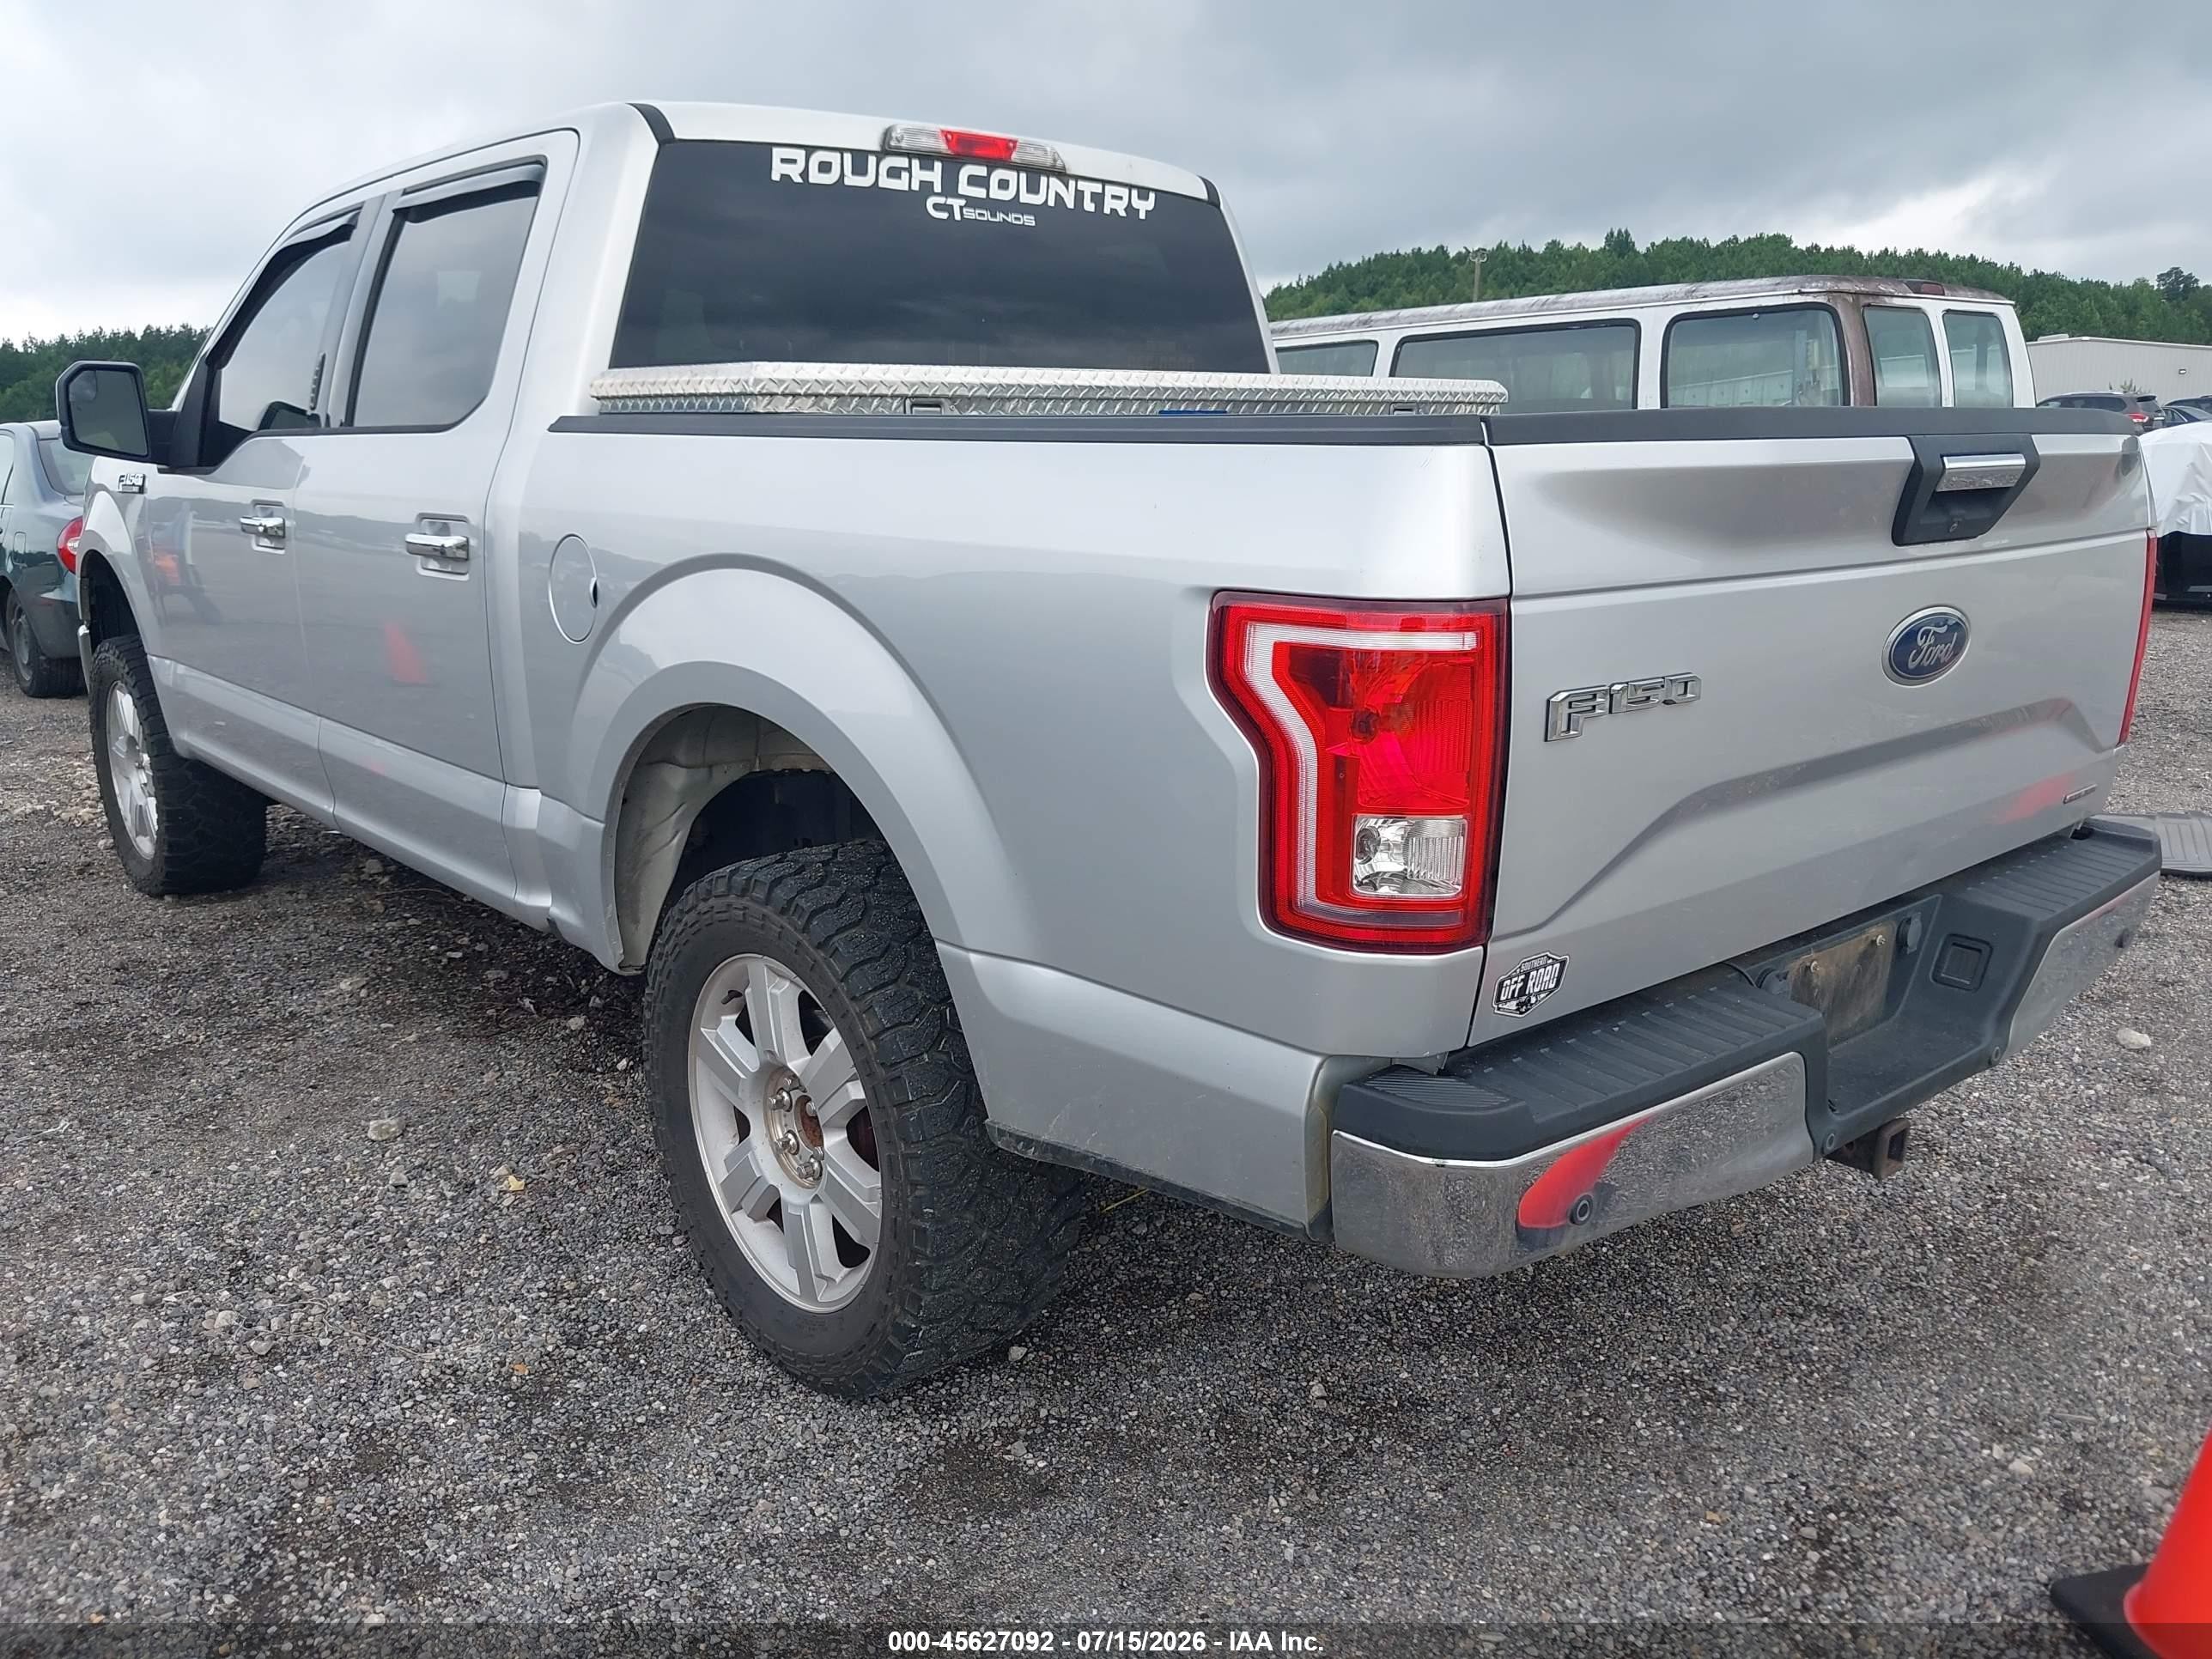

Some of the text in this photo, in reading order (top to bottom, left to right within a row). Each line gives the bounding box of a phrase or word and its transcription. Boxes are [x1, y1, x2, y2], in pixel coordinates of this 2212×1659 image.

[771, 148, 1156, 220] ROUGH COUNTRY
[1908, 625, 1957, 670] Ford
[1545, 672, 1702, 743] F150
[1500, 963, 1561, 1001] OFF ROAD
